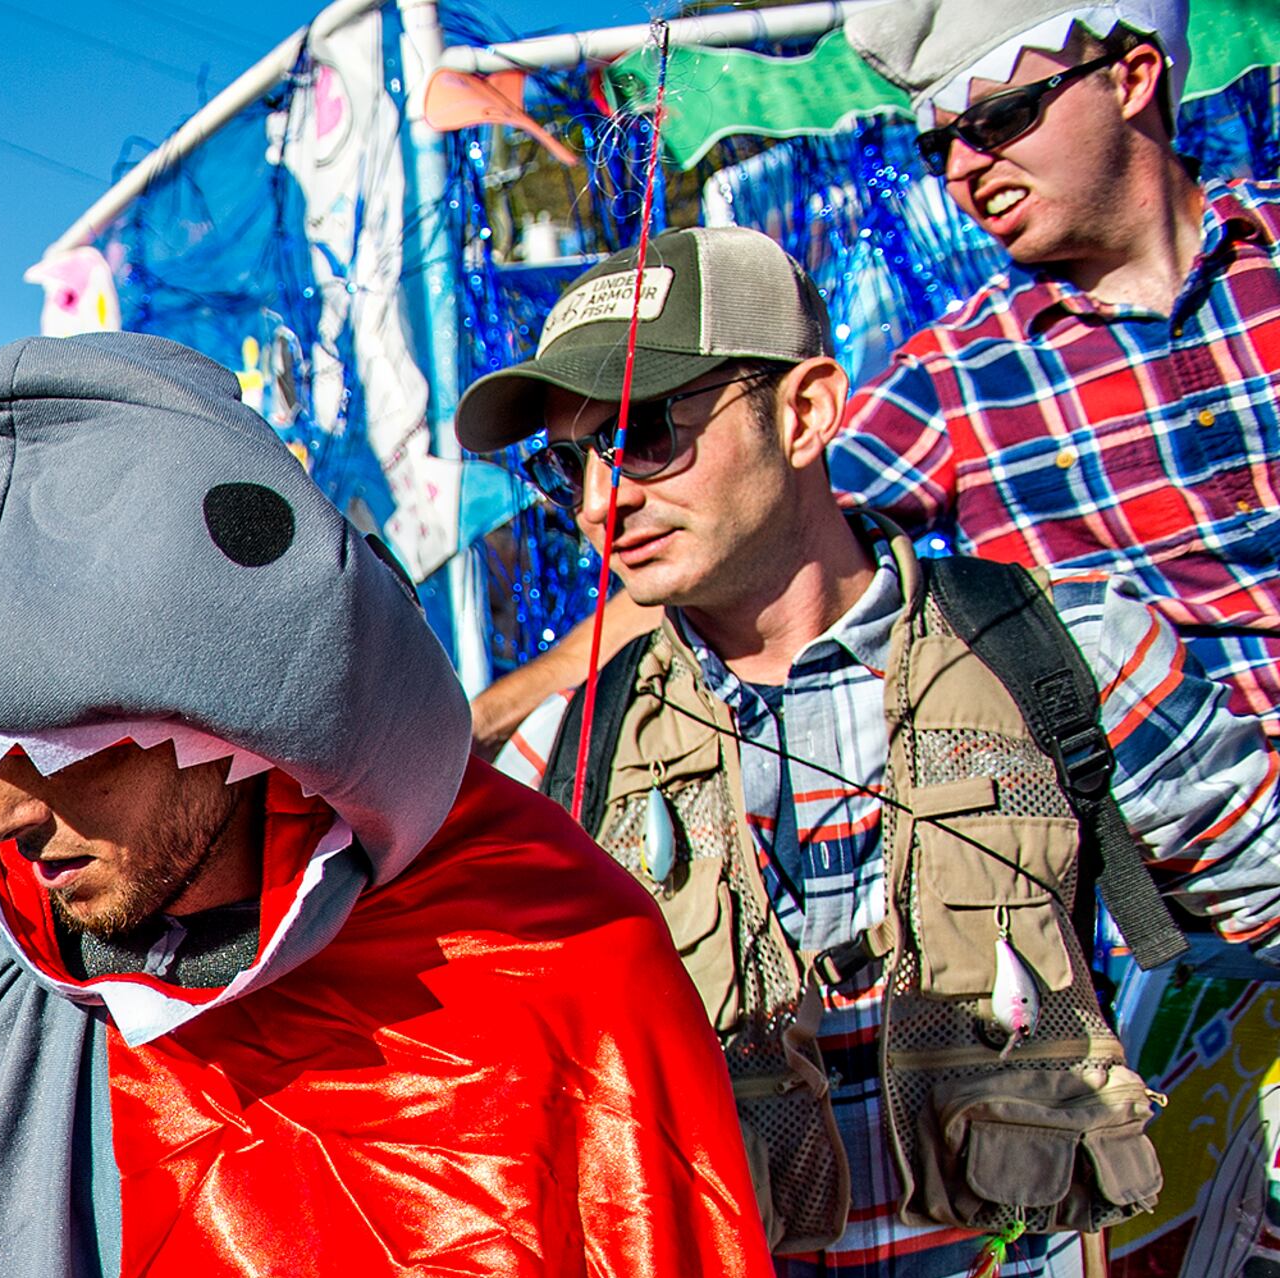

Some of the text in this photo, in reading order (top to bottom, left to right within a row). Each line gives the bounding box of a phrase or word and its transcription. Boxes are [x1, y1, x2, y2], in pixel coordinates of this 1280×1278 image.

[592, 273, 647, 292] UNDE
[586, 286, 658, 305] ARMOUR
[580, 303, 617, 319] FISH
